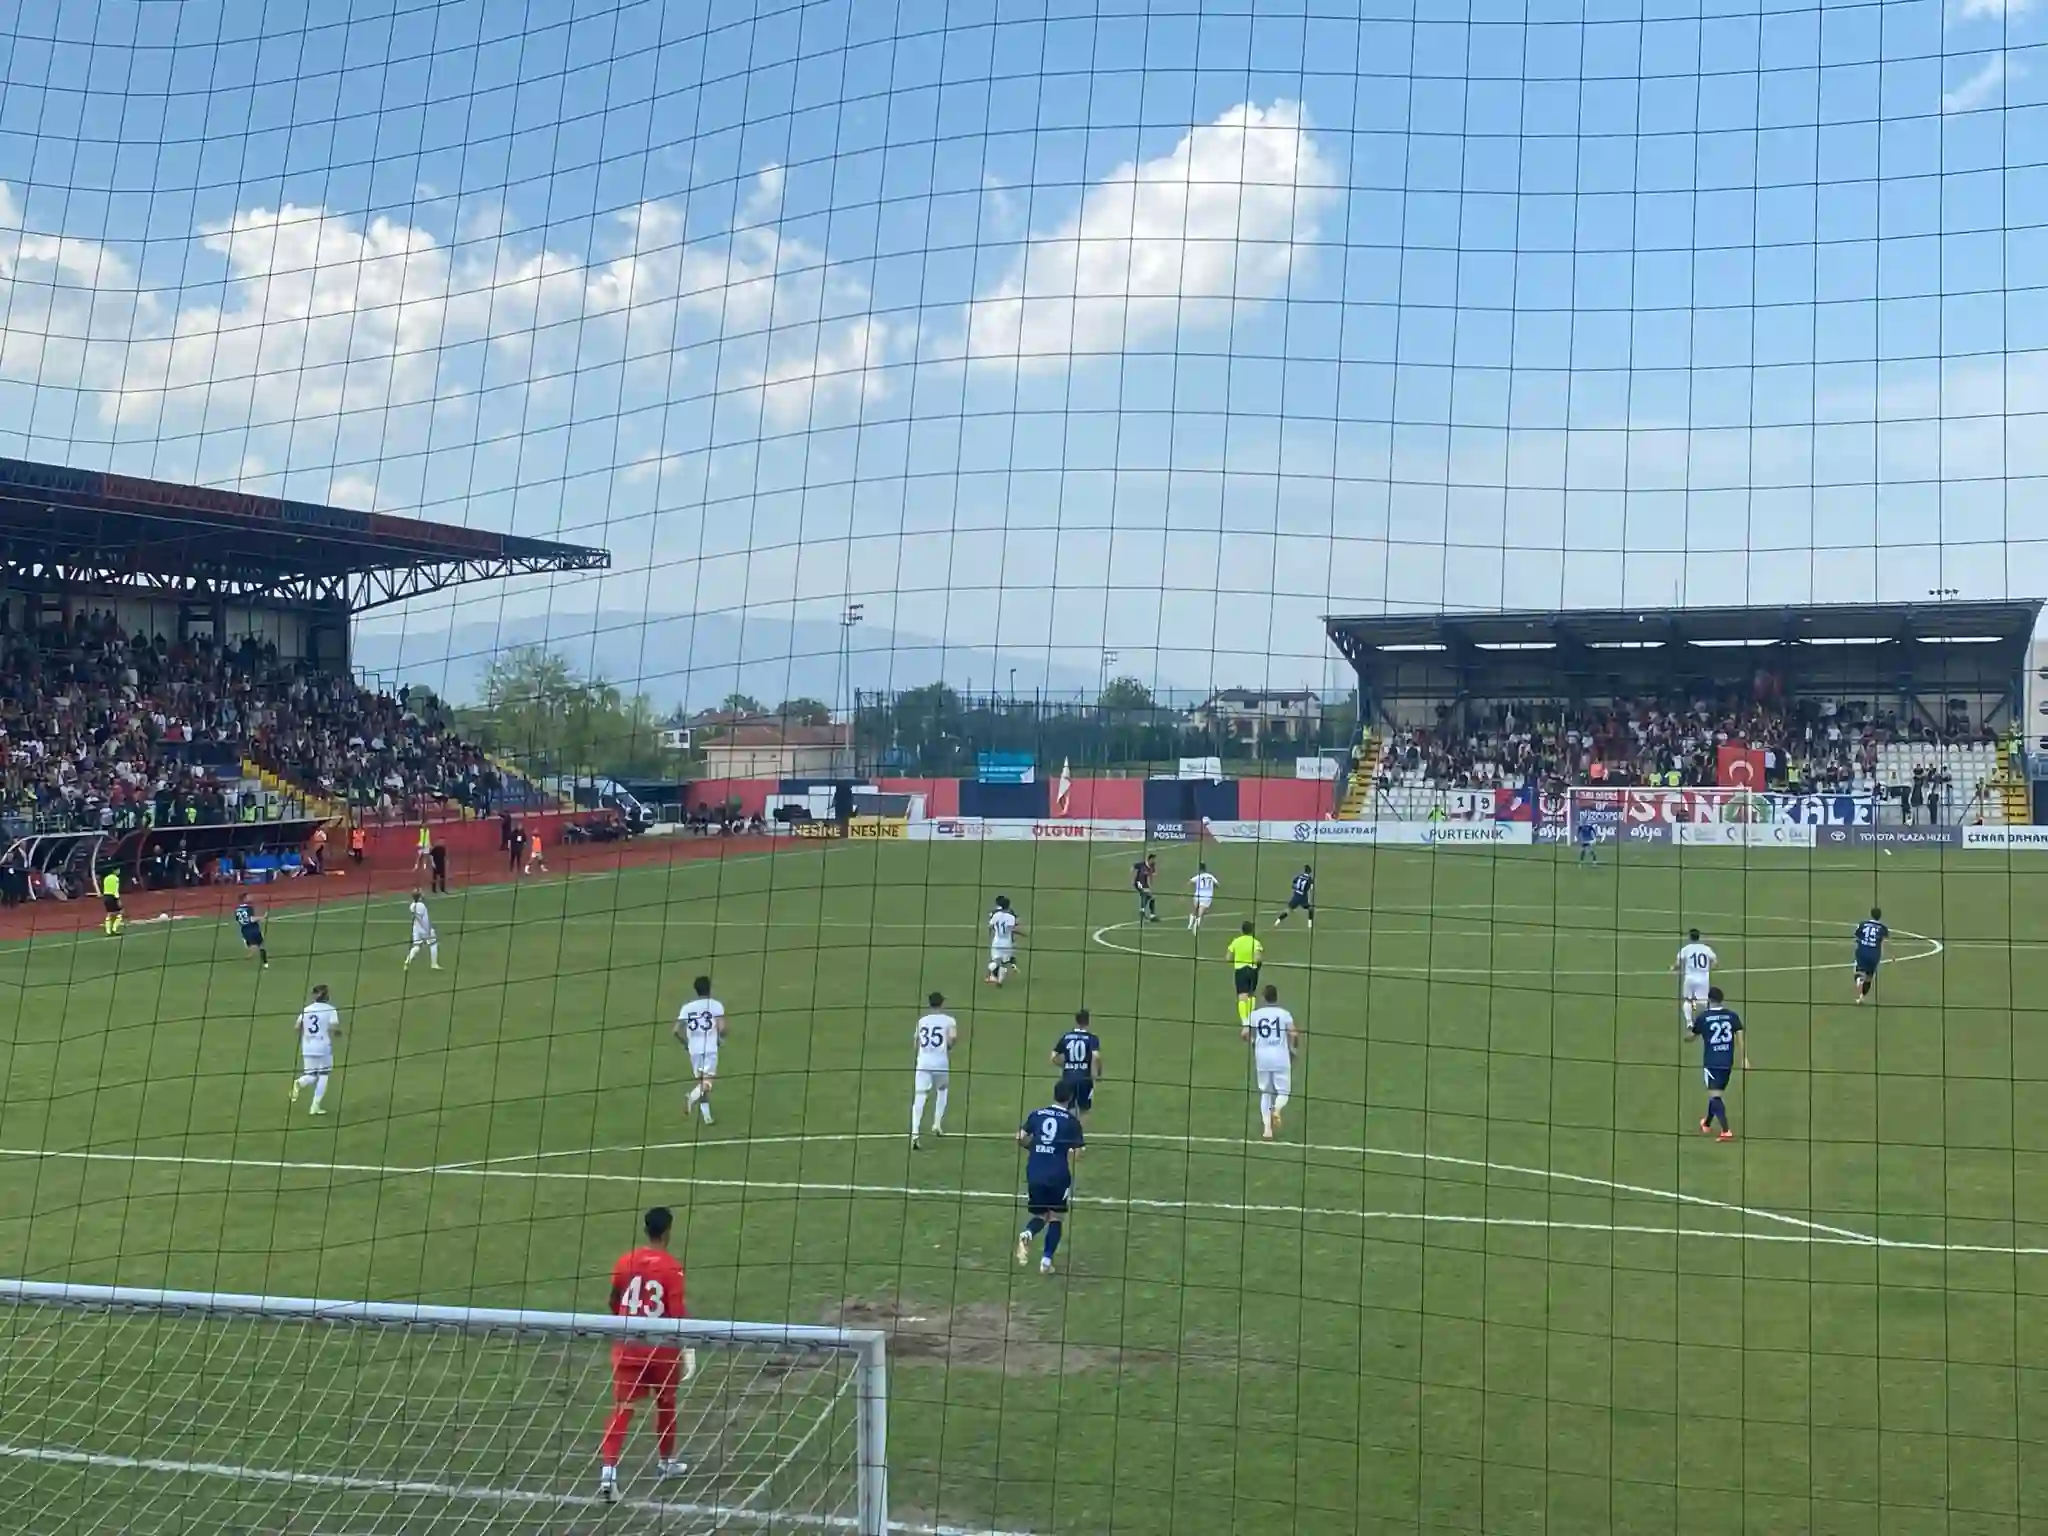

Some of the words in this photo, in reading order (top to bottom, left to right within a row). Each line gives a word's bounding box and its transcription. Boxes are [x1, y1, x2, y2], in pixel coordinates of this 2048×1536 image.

[1689, 952, 1708, 969] 10
[308, 1015, 320, 1034] 3
[687, 1011, 713, 1031] 53
[1258, 1017, 1281, 1038] 61
[920, 1026, 944, 1048] 35
[1710, 1021, 1733, 1044] 23
[1066, 1039, 1086, 1062] 10
[1041, 1117, 1058, 1144] 9
[621, 1276, 665, 1318] 43
